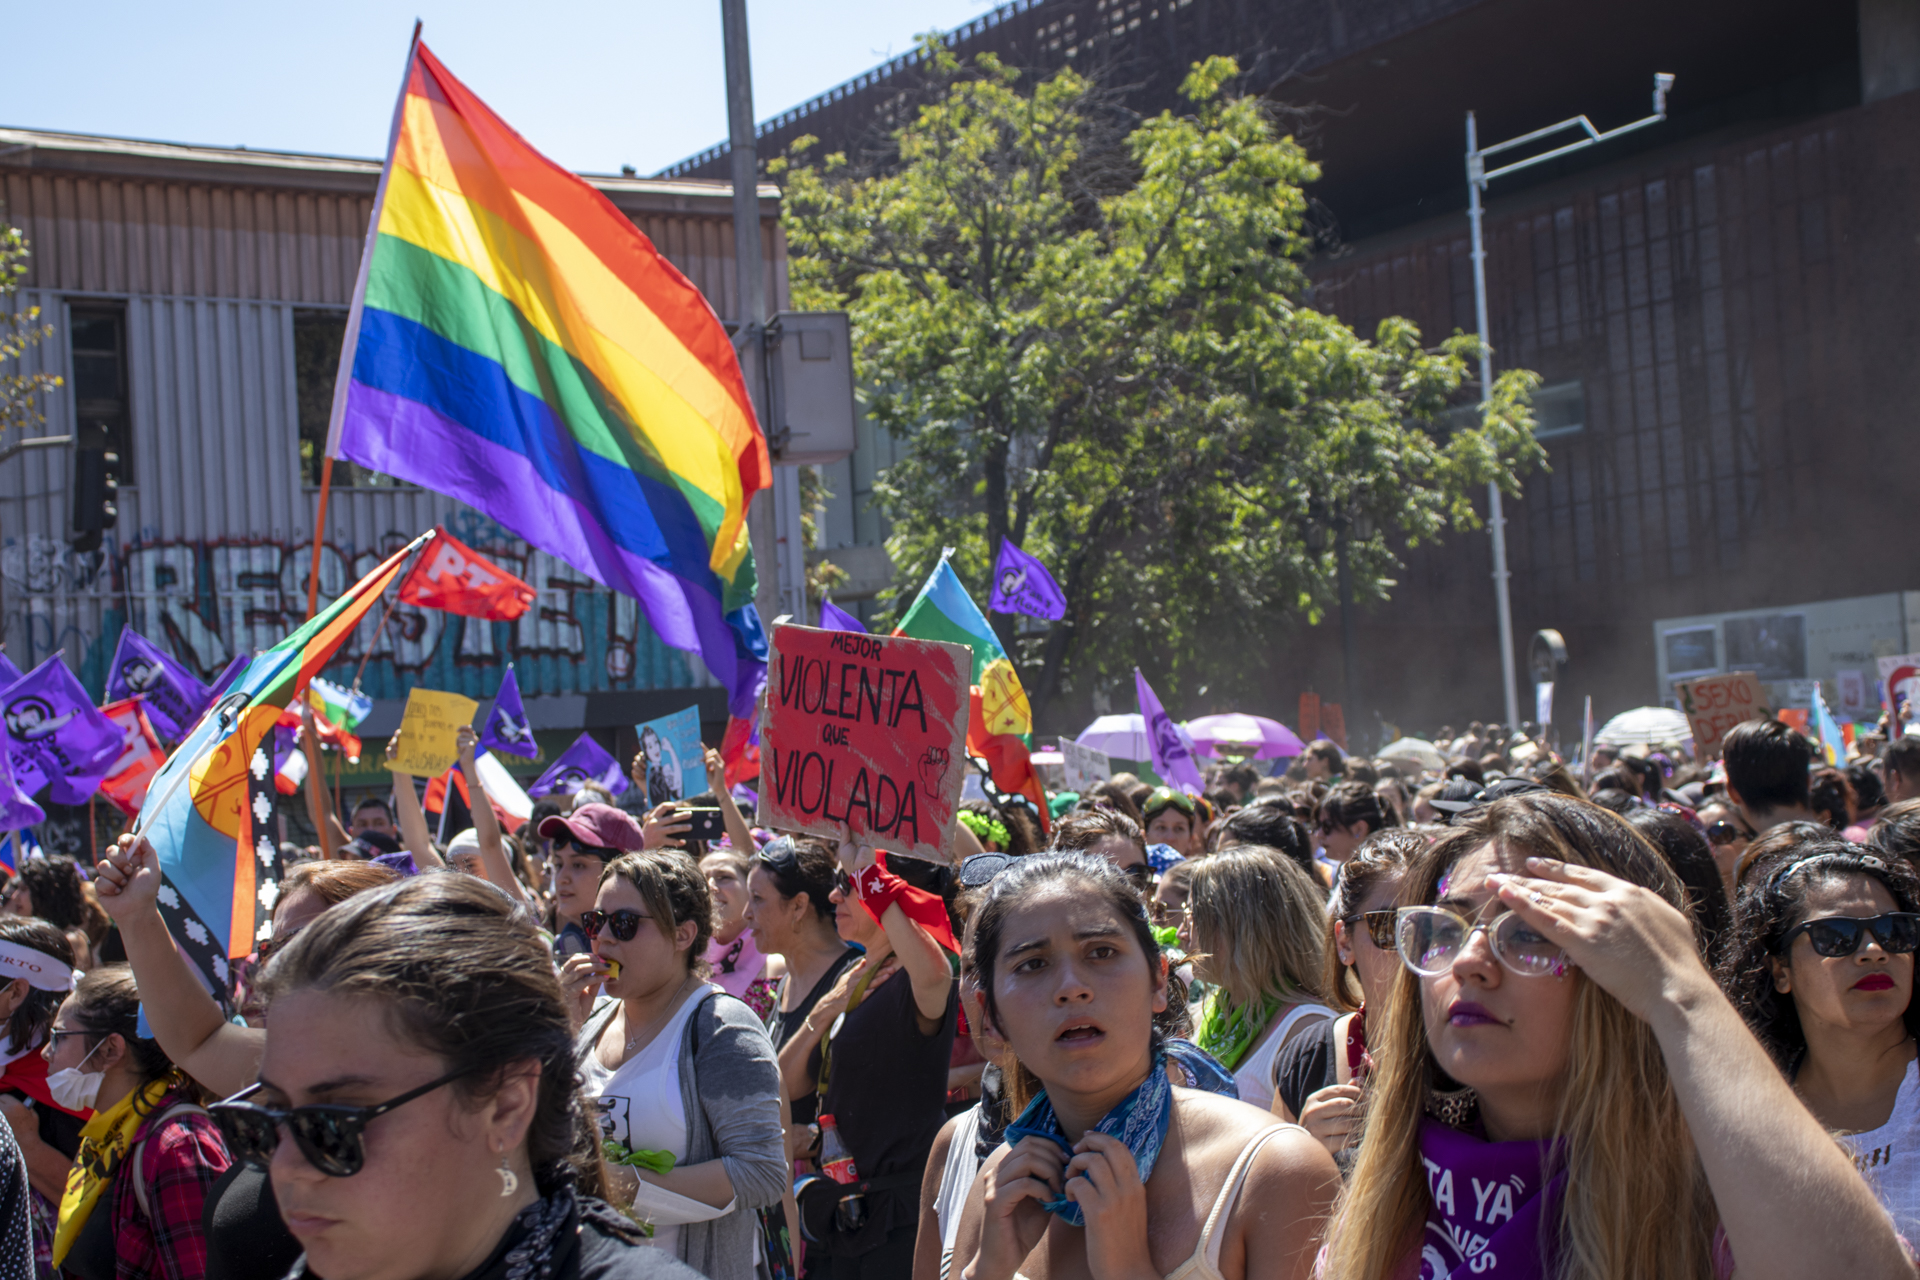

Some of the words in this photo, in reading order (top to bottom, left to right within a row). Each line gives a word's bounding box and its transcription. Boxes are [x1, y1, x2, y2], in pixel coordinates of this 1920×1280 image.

[830, 632, 883, 662] MEJOR
[780, 654, 928, 733] VIOLENTA
[1695, 680, 1753, 711] SEXO
[822, 723, 850, 747] QUE
[773, 748, 919, 844] VIOLADA
[1471, 1177, 1514, 1225] YA
